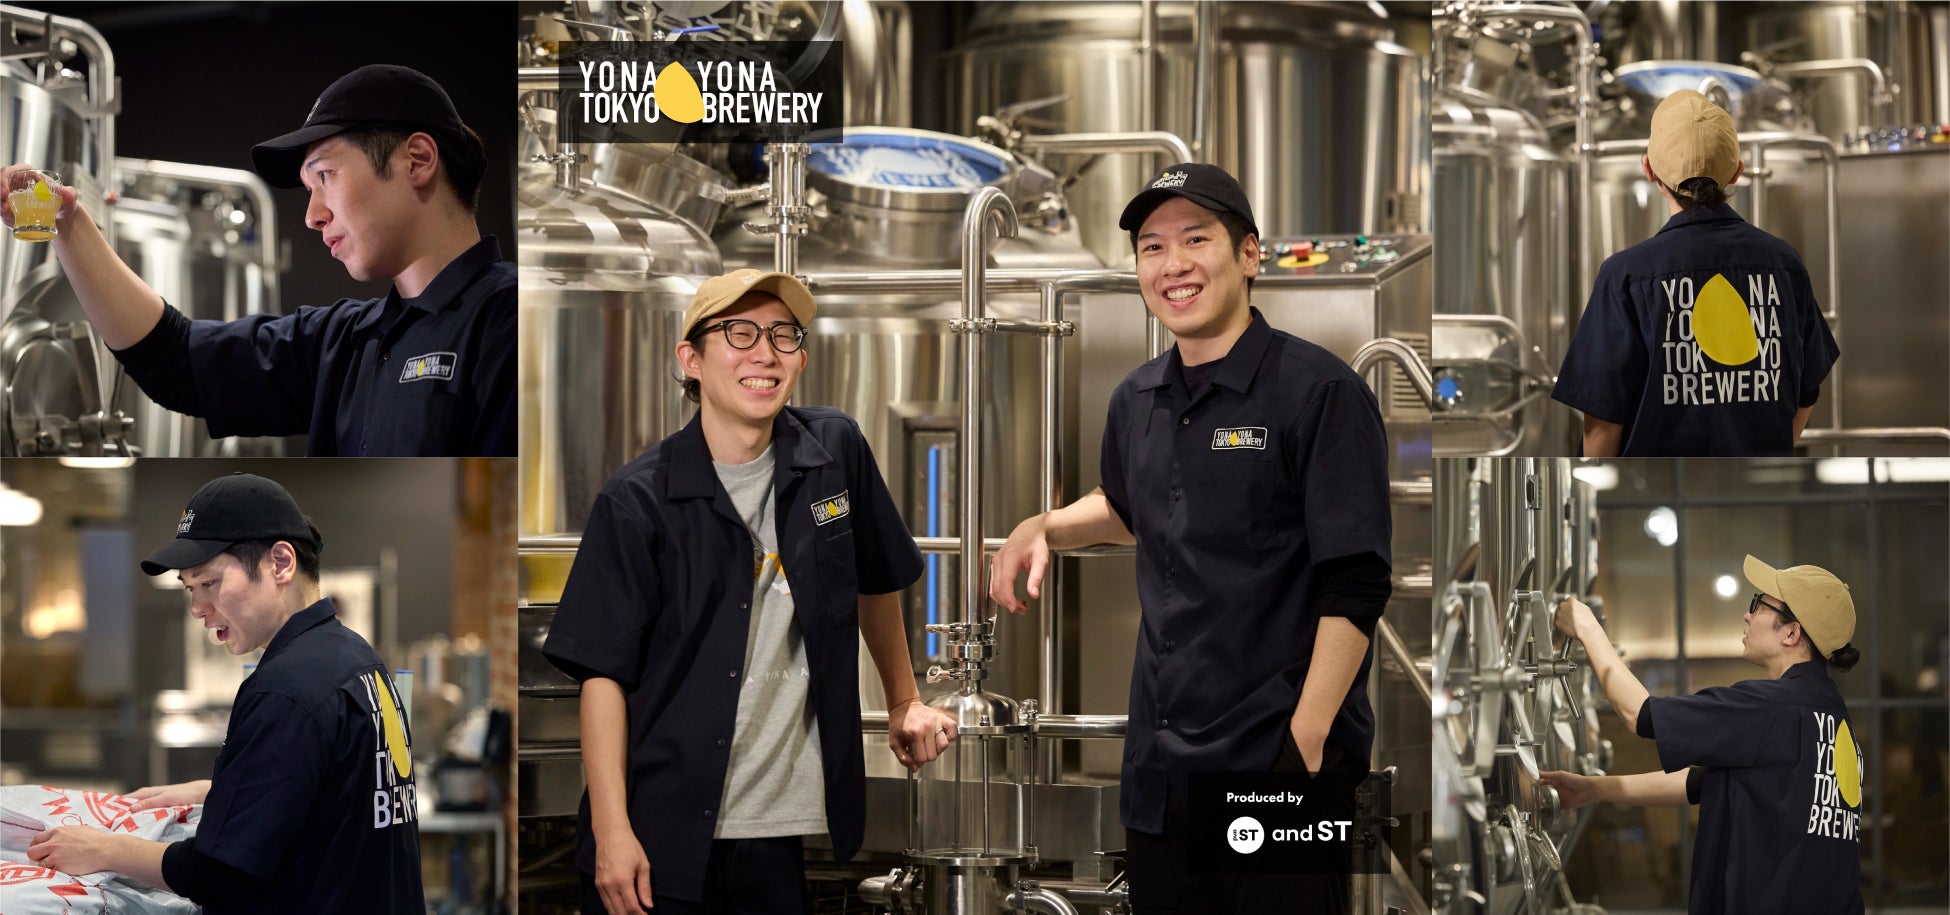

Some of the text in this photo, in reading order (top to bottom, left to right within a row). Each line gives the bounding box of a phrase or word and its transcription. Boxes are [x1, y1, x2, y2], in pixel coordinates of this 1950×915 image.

[1661, 274, 1781, 312] YO NA
[1665, 306, 1782, 342] YO NA
[1662, 337, 1781, 373] TOK YO
[1663, 369, 1781, 406] BREWERY
[1813, 711, 1835, 745] YO
[1816, 741, 1836, 776] YO
[1813, 773, 1840, 807] TOK
[1807, 804, 1860, 843] BREWE
